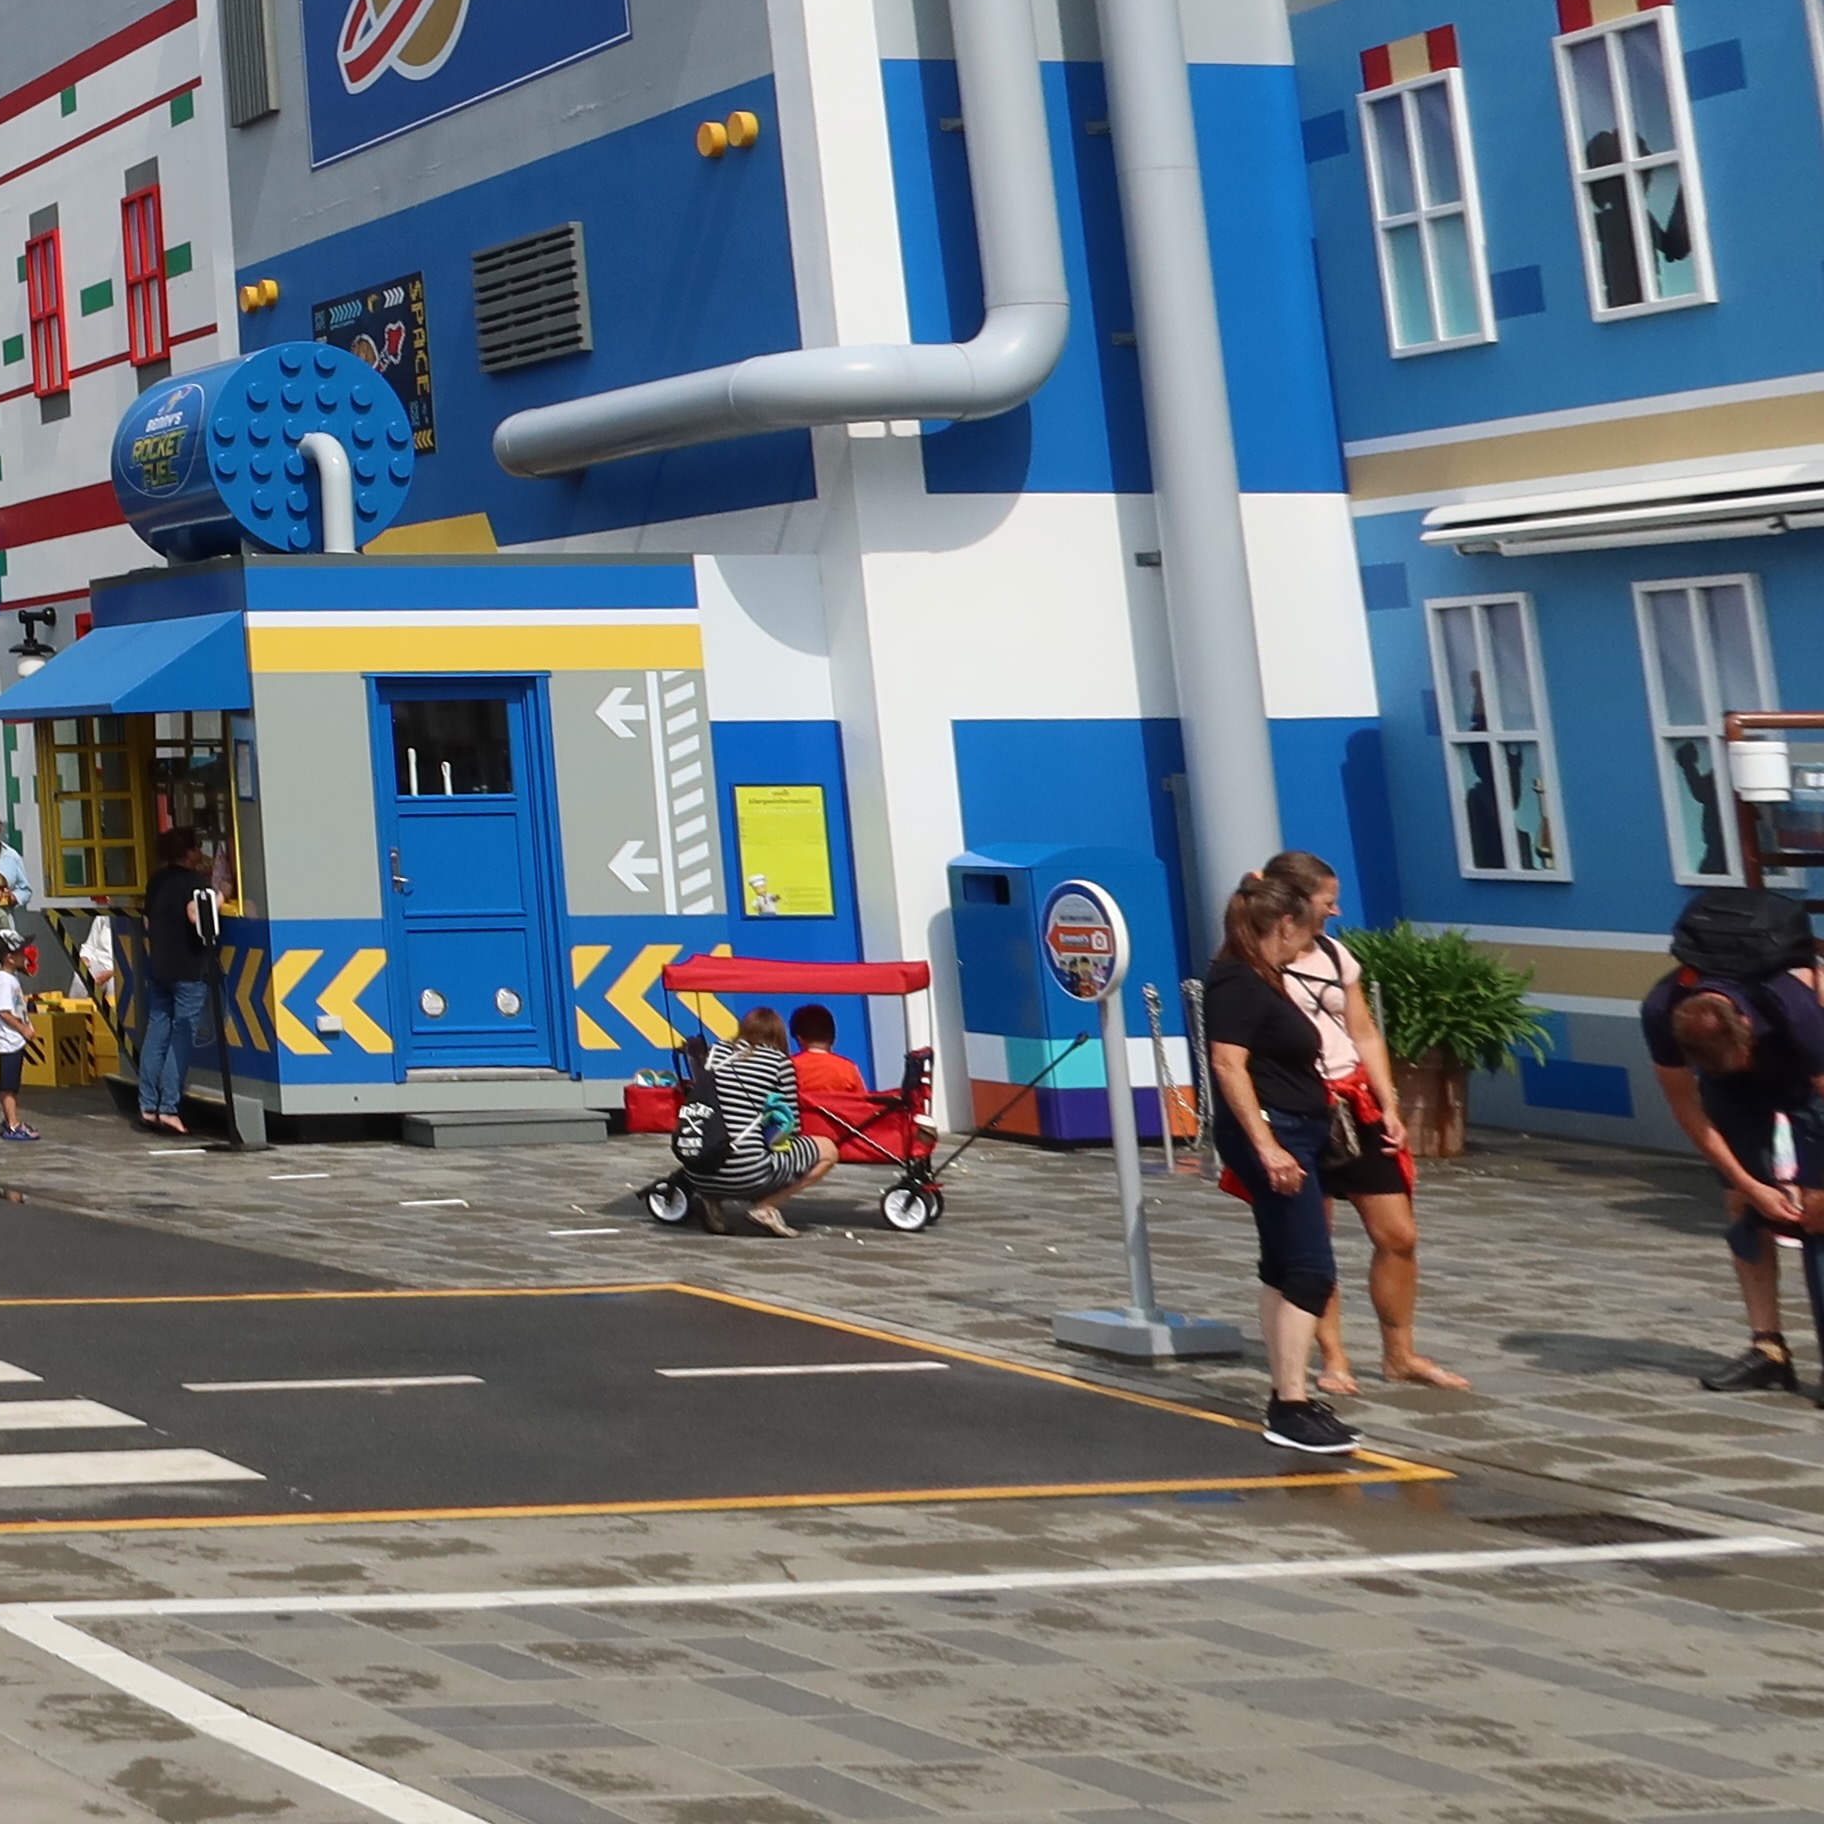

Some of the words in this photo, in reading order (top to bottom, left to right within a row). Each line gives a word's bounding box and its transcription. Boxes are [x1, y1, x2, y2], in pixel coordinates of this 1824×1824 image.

[409, 280, 431, 396] SPACE
[132, 427, 190, 463] ROCKET
[142, 460, 180, 491] FUEL
